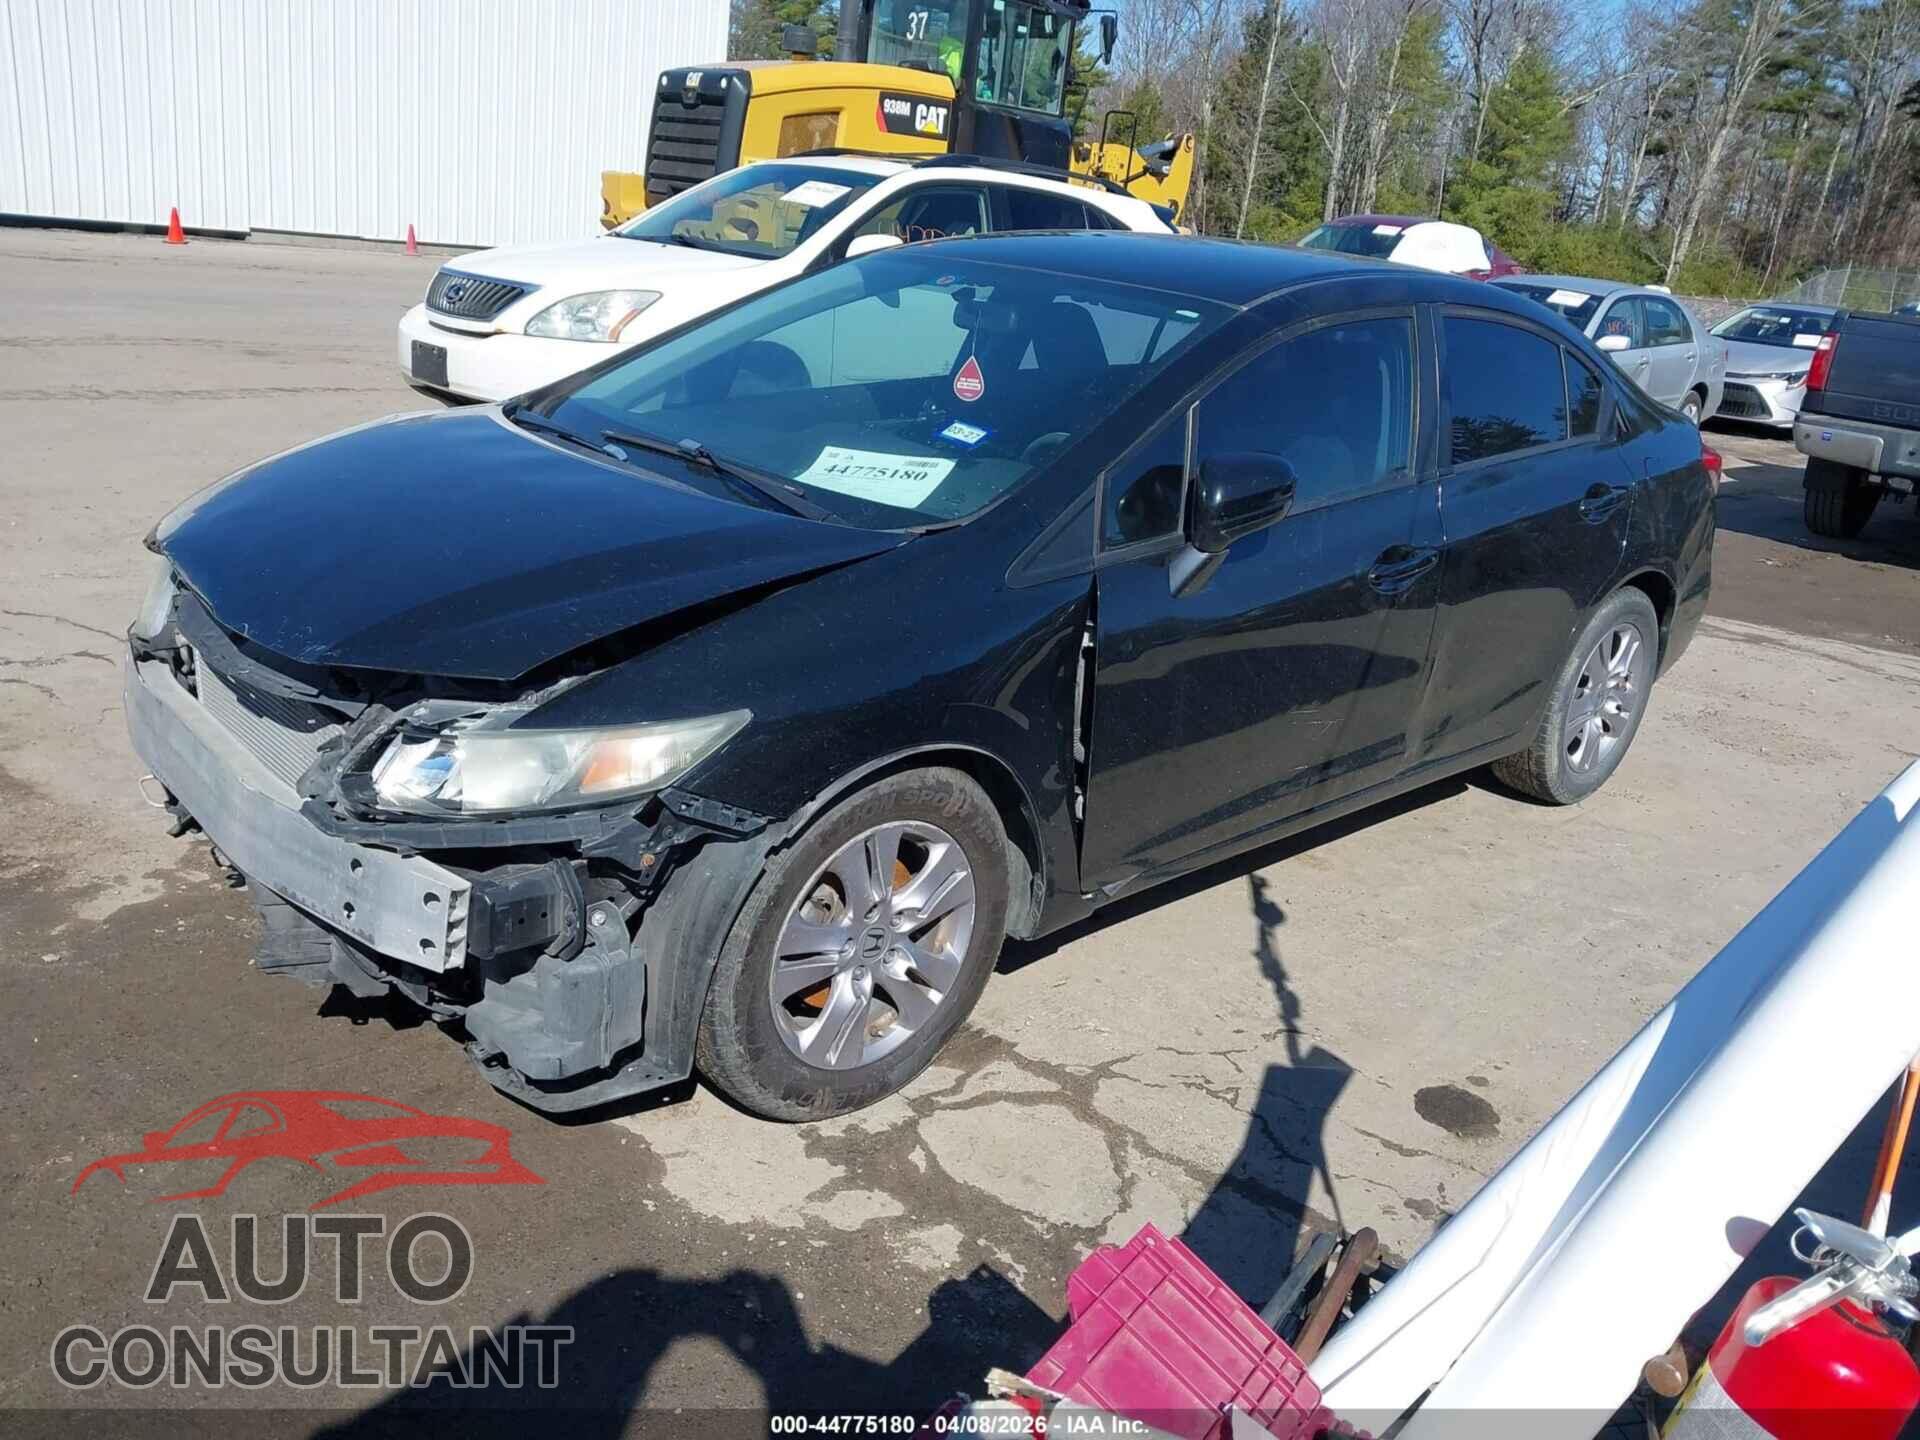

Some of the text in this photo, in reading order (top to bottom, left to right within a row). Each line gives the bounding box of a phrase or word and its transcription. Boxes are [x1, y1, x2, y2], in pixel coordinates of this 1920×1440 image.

[906, 12, 929, 41] 37
[686, 71, 704, 87] CAT
[883, 98, 911, 117] 938M
[914, 103, 948, 134] CAT
[823, 463, 929, 482] 44775180
